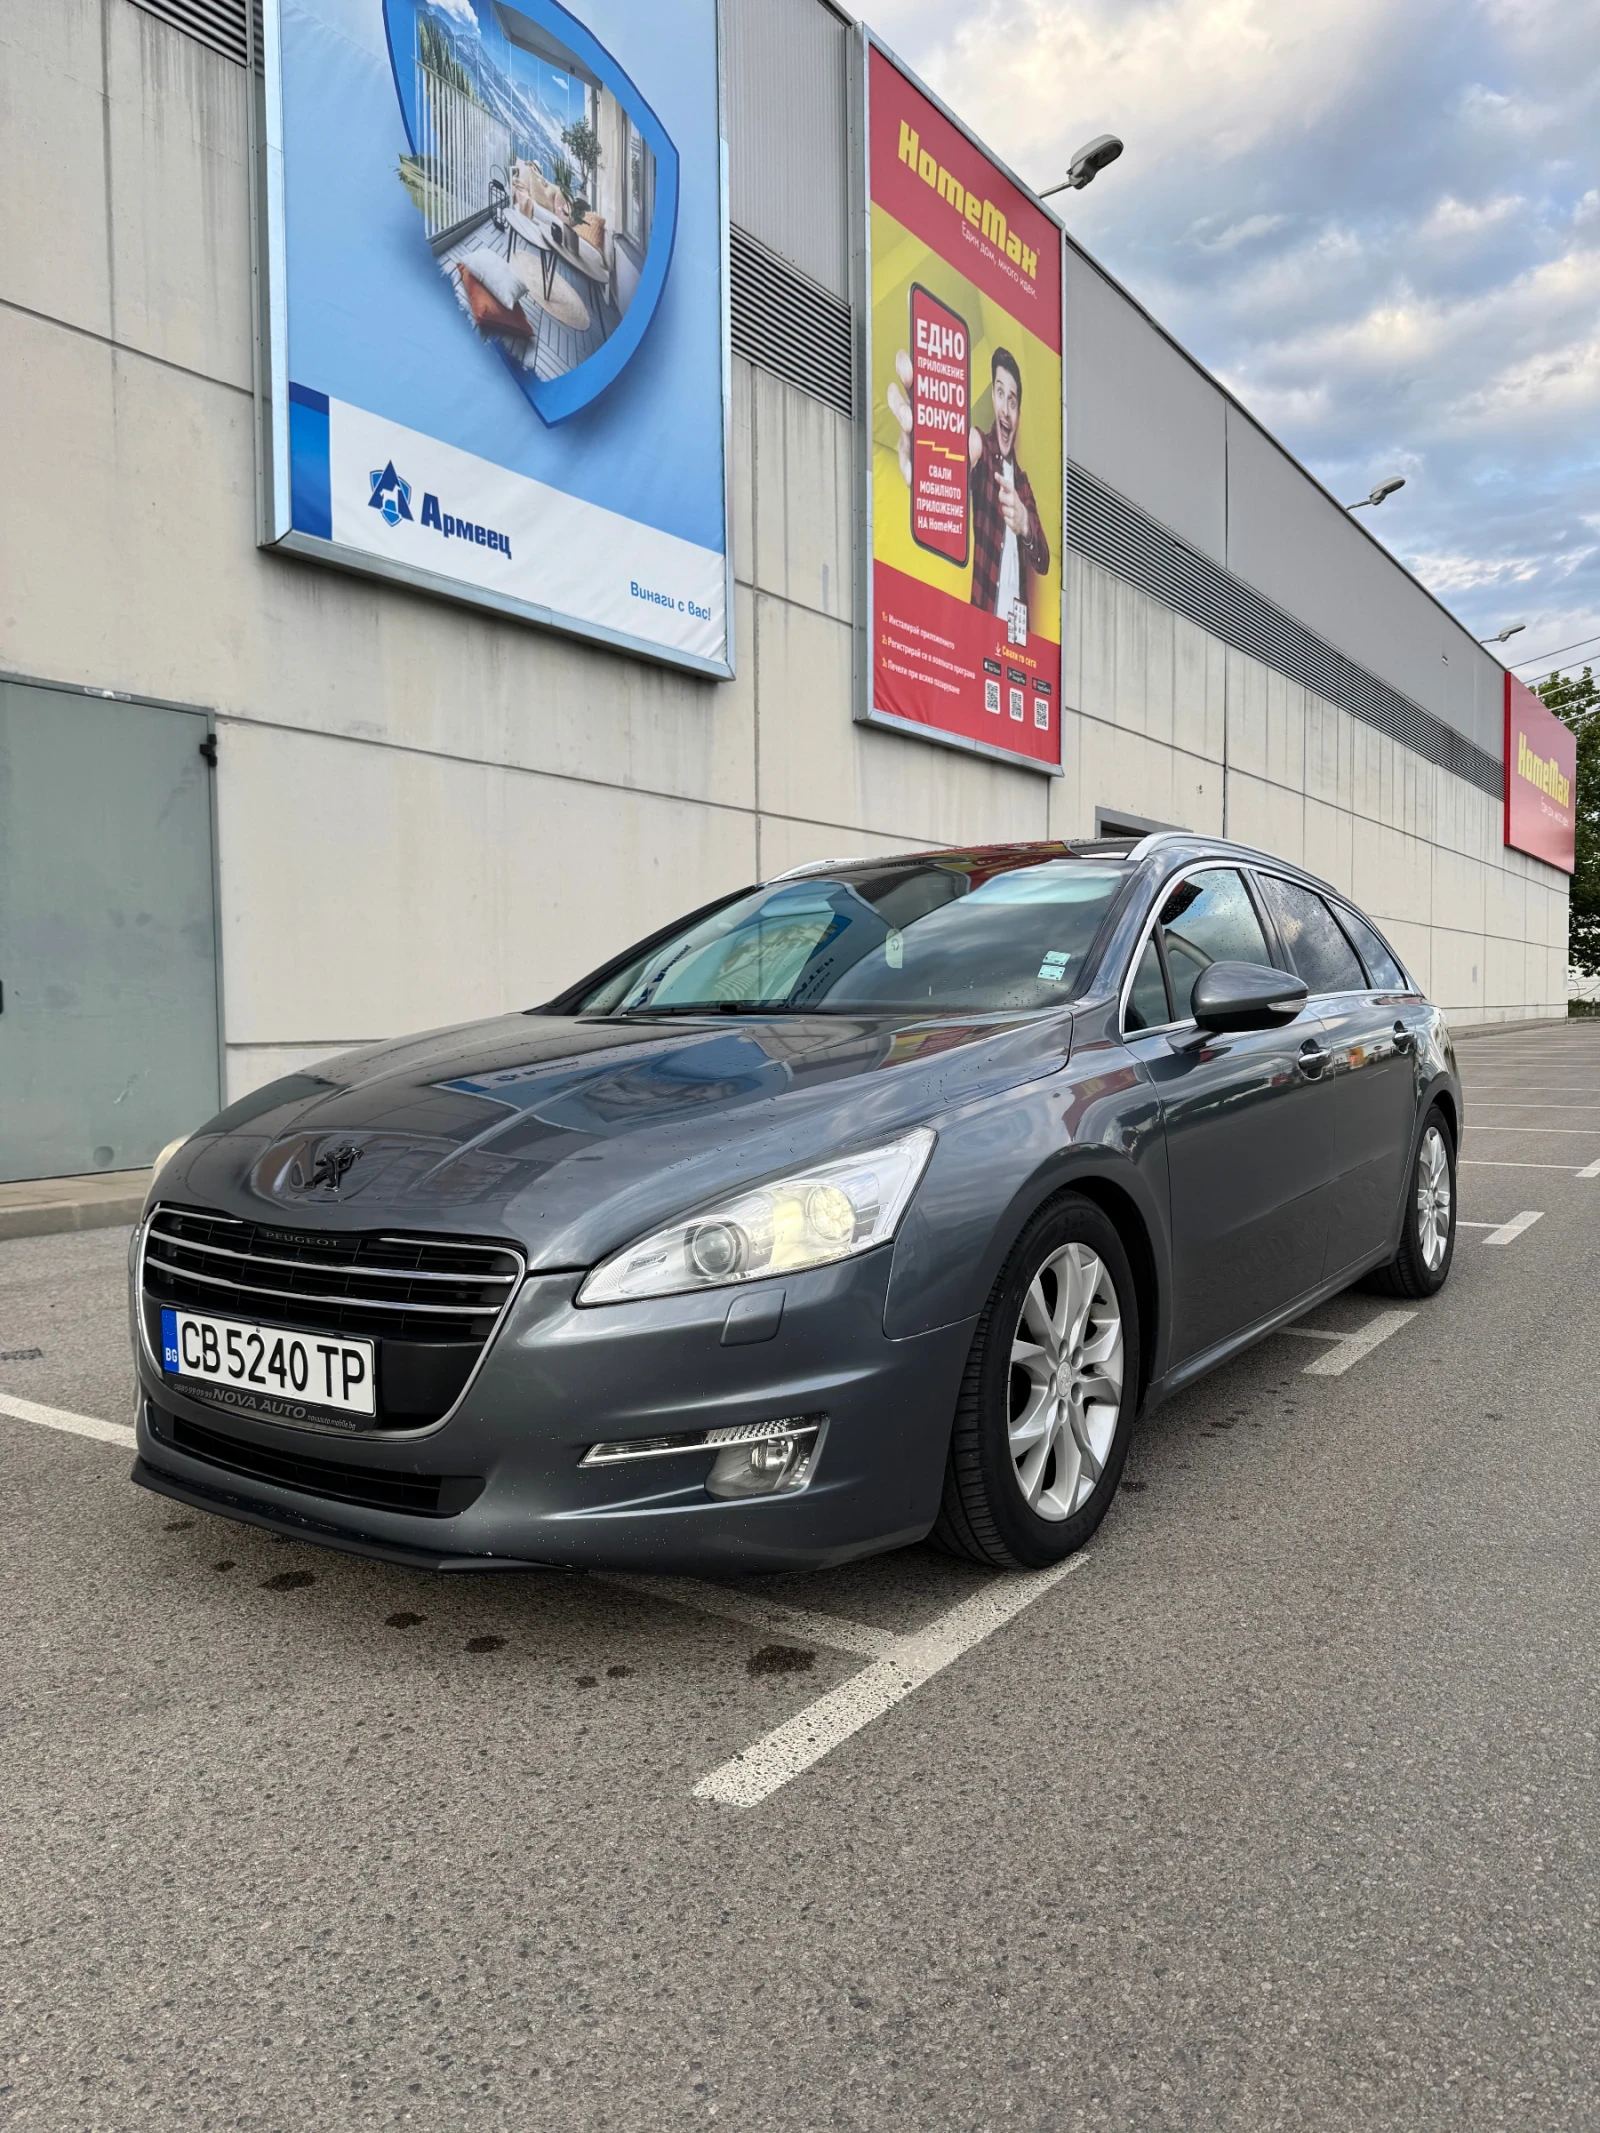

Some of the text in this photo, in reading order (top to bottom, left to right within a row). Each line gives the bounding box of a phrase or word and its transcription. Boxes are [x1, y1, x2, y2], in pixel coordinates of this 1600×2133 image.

[898, 118, 1038, 280] HomeMax
[961, 220, 979, 249] Един
[998, 258, 1019, 283] много
[917, 317, 965, 361] ЕДНО
[917, 355, 965, 381] ПРИЛОЖЕНИЕ
[917, 373, 965, 408] МНОГО
[917, 403, 965, 435] БОНУСИ
[928, 464, 952, 481] СВАЛИ
[920, 480, 962, 500] МОБИЛНОТО
[916, 497, 964, 518] ПРИЛОЖЕНИЕ
[420, 492, 512, 560] Армеец
[917, 515, 963, 535] НА HomeMax!
[630, 580, 675, 609] Винаги
[677, 600, 685, 612] с
[1517, 731, 1570, 809] HomeMax
[266, 1231, 340, 1247] PEUGEOT
[165, 1347, 178, 1363] BG
[226, 1328, 309, 1392] 5240
[316, 1344, 365, 1401] TP
[213, 1388, 257, 1409] NOVA
[260, 1399, 307, 1420] AUTO
